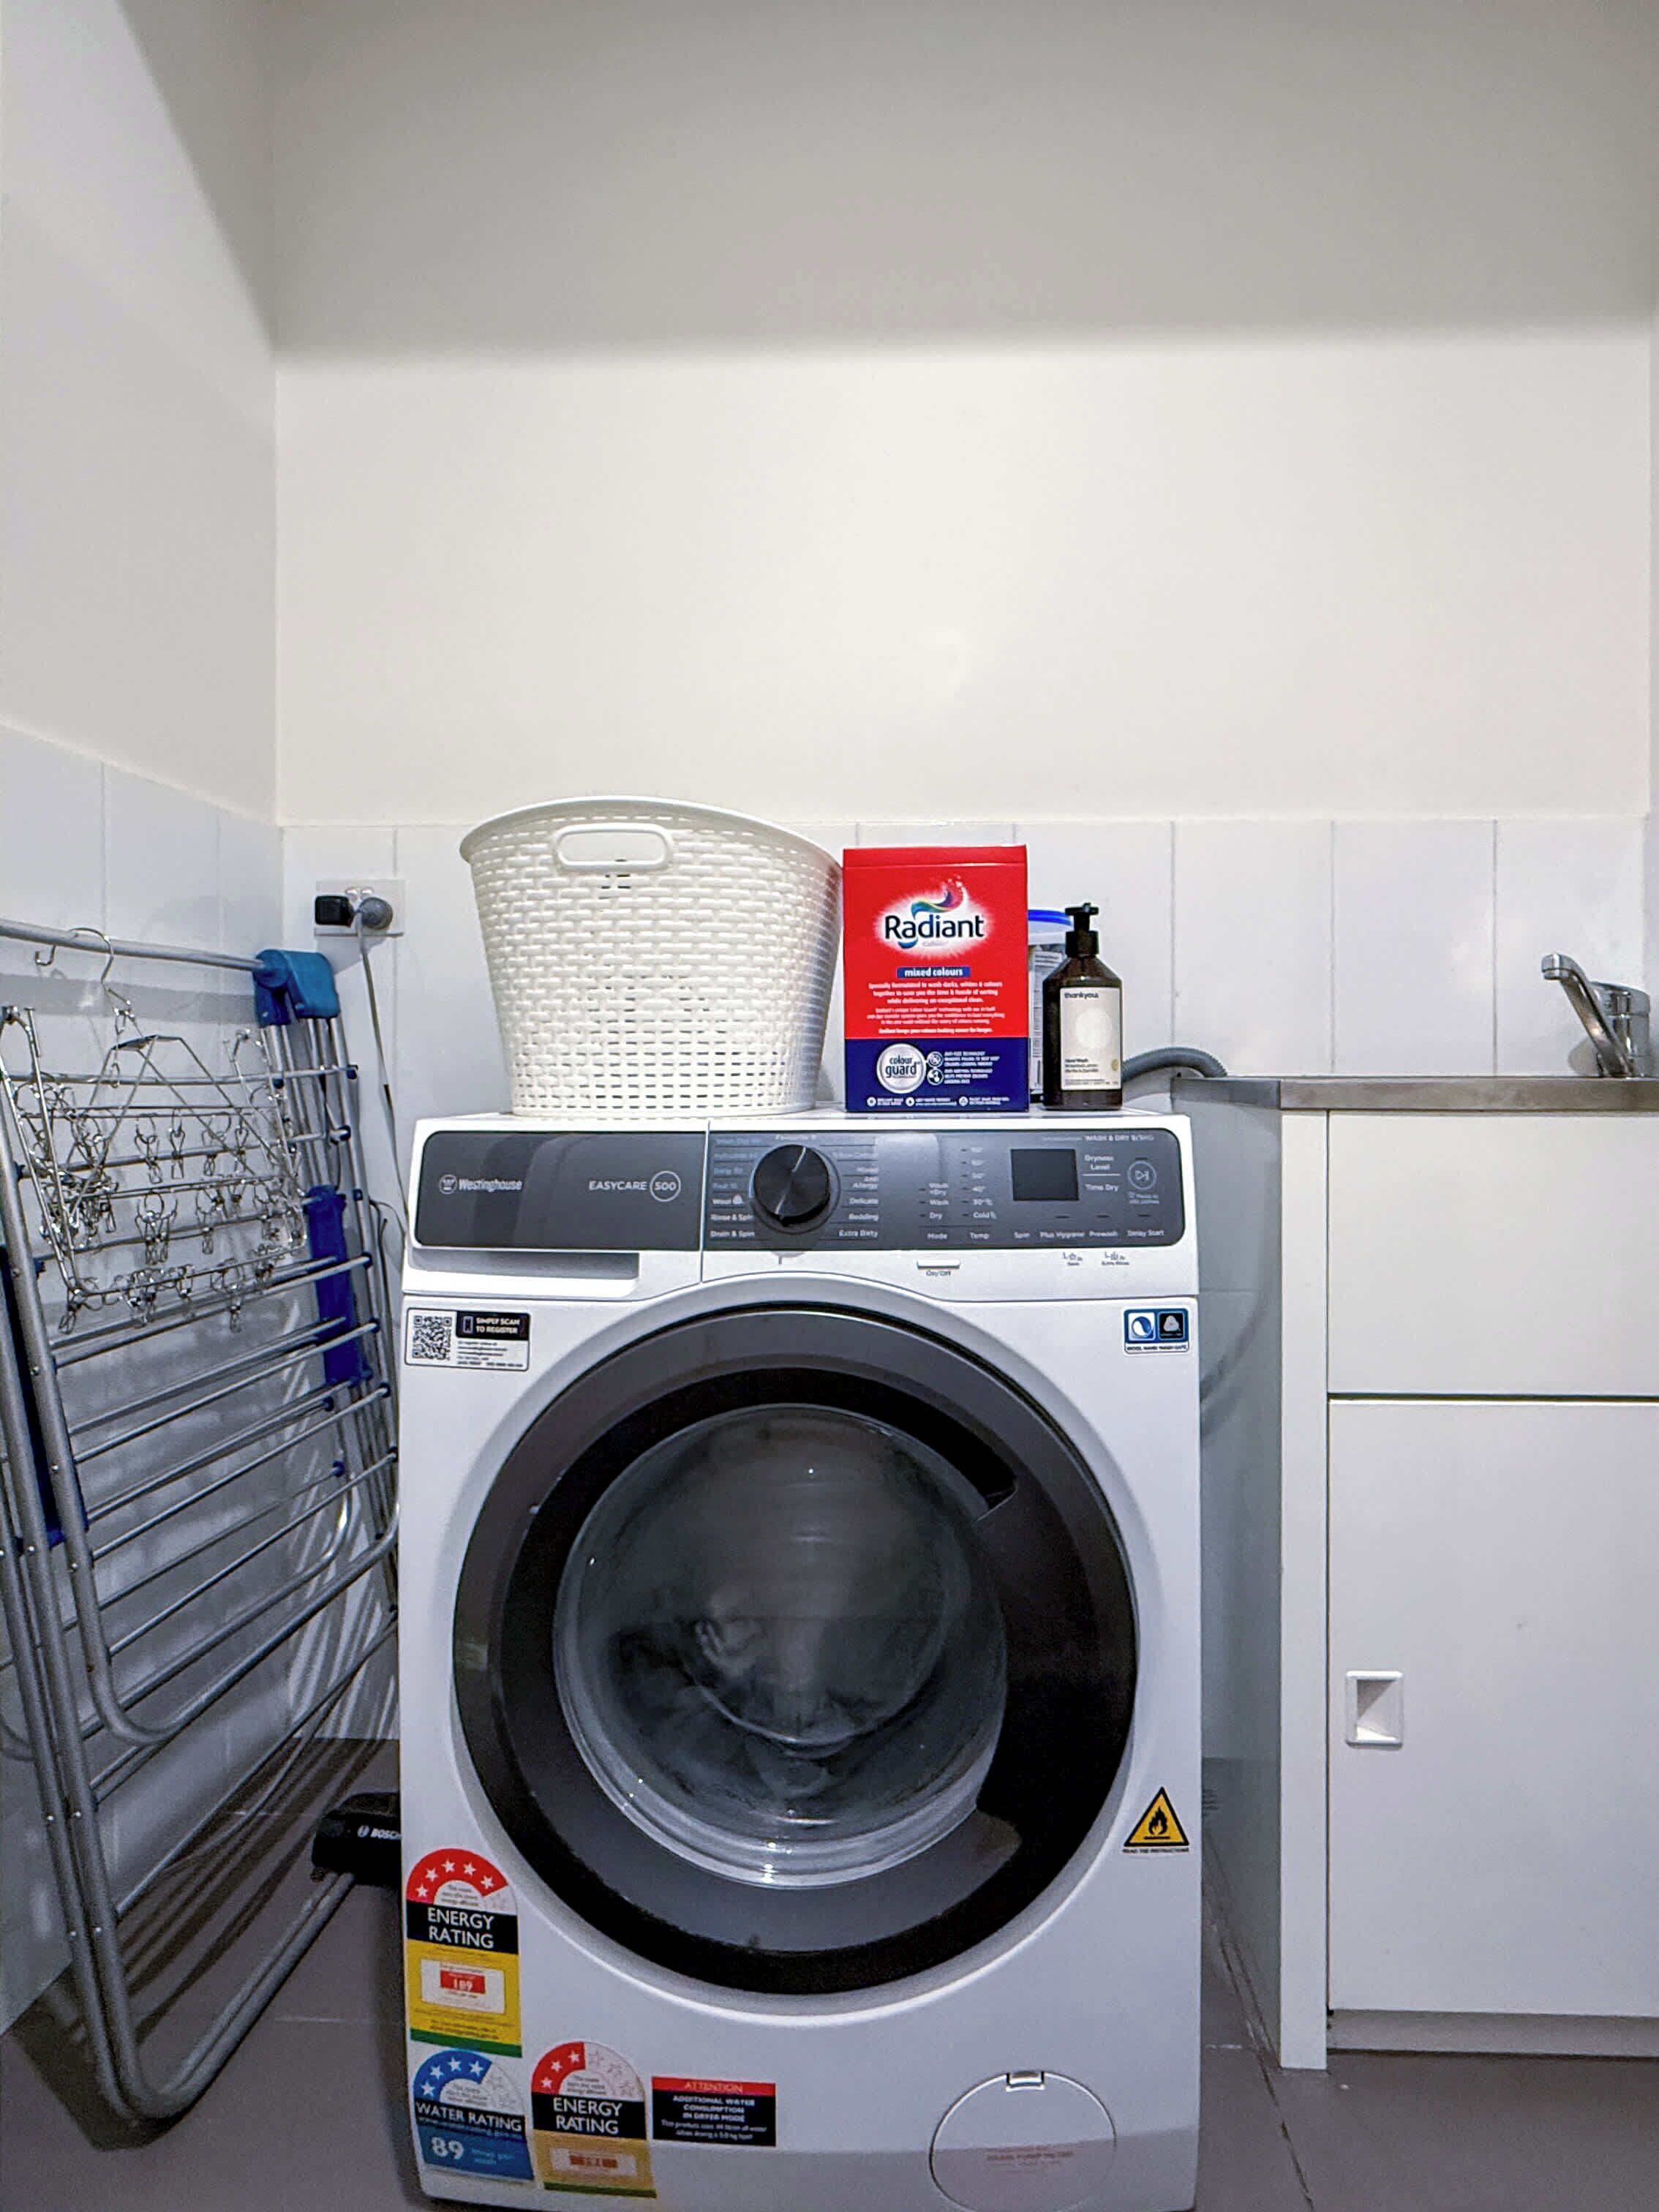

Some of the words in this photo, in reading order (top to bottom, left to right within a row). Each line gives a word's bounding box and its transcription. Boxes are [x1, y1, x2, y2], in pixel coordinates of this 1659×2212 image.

[885, 914, 984, 939] Radiant
[905, 967, 931, 977] mixed
[933, 966, 963, 977] colours
[889, 1055, 912, 1064] colour
[885, 1062, 917, 1077] guard
[459, 1178, 522, 1192] Westinghouse
[589, 1181, 647, 1191] EASYCARE
[654, 1181, 677, 1191] 500
[1105, 1184, 1118, 1192] Dry
[476, 1317, 499, 1325] SIMPLY
[500, 1318, 520, 1326] SCAN
[486, 1326, 518, 1334] REGISTER
[427, 1906, 494, 1930] ENERGY
[429, 1925, 494, 1949] RATING
[685, 2080, 743, 2093] ATTENTION
[553, 2096, 622, 2117] ENERGY
[673, 2095, 723, 2104] ADDITIONAL
[725, 2098, 756, 2107] WATER
[683, 2104, 745, 2113] CONSUMPTION
[416, 2102, 464, 2123] WATER
[469, 2112, 522, 2132] RATING
[721, 2115, 745, 2123] MODE
[556, 2115, 619, 2135] RATING
[431, 2136, 464, 2160] 89
